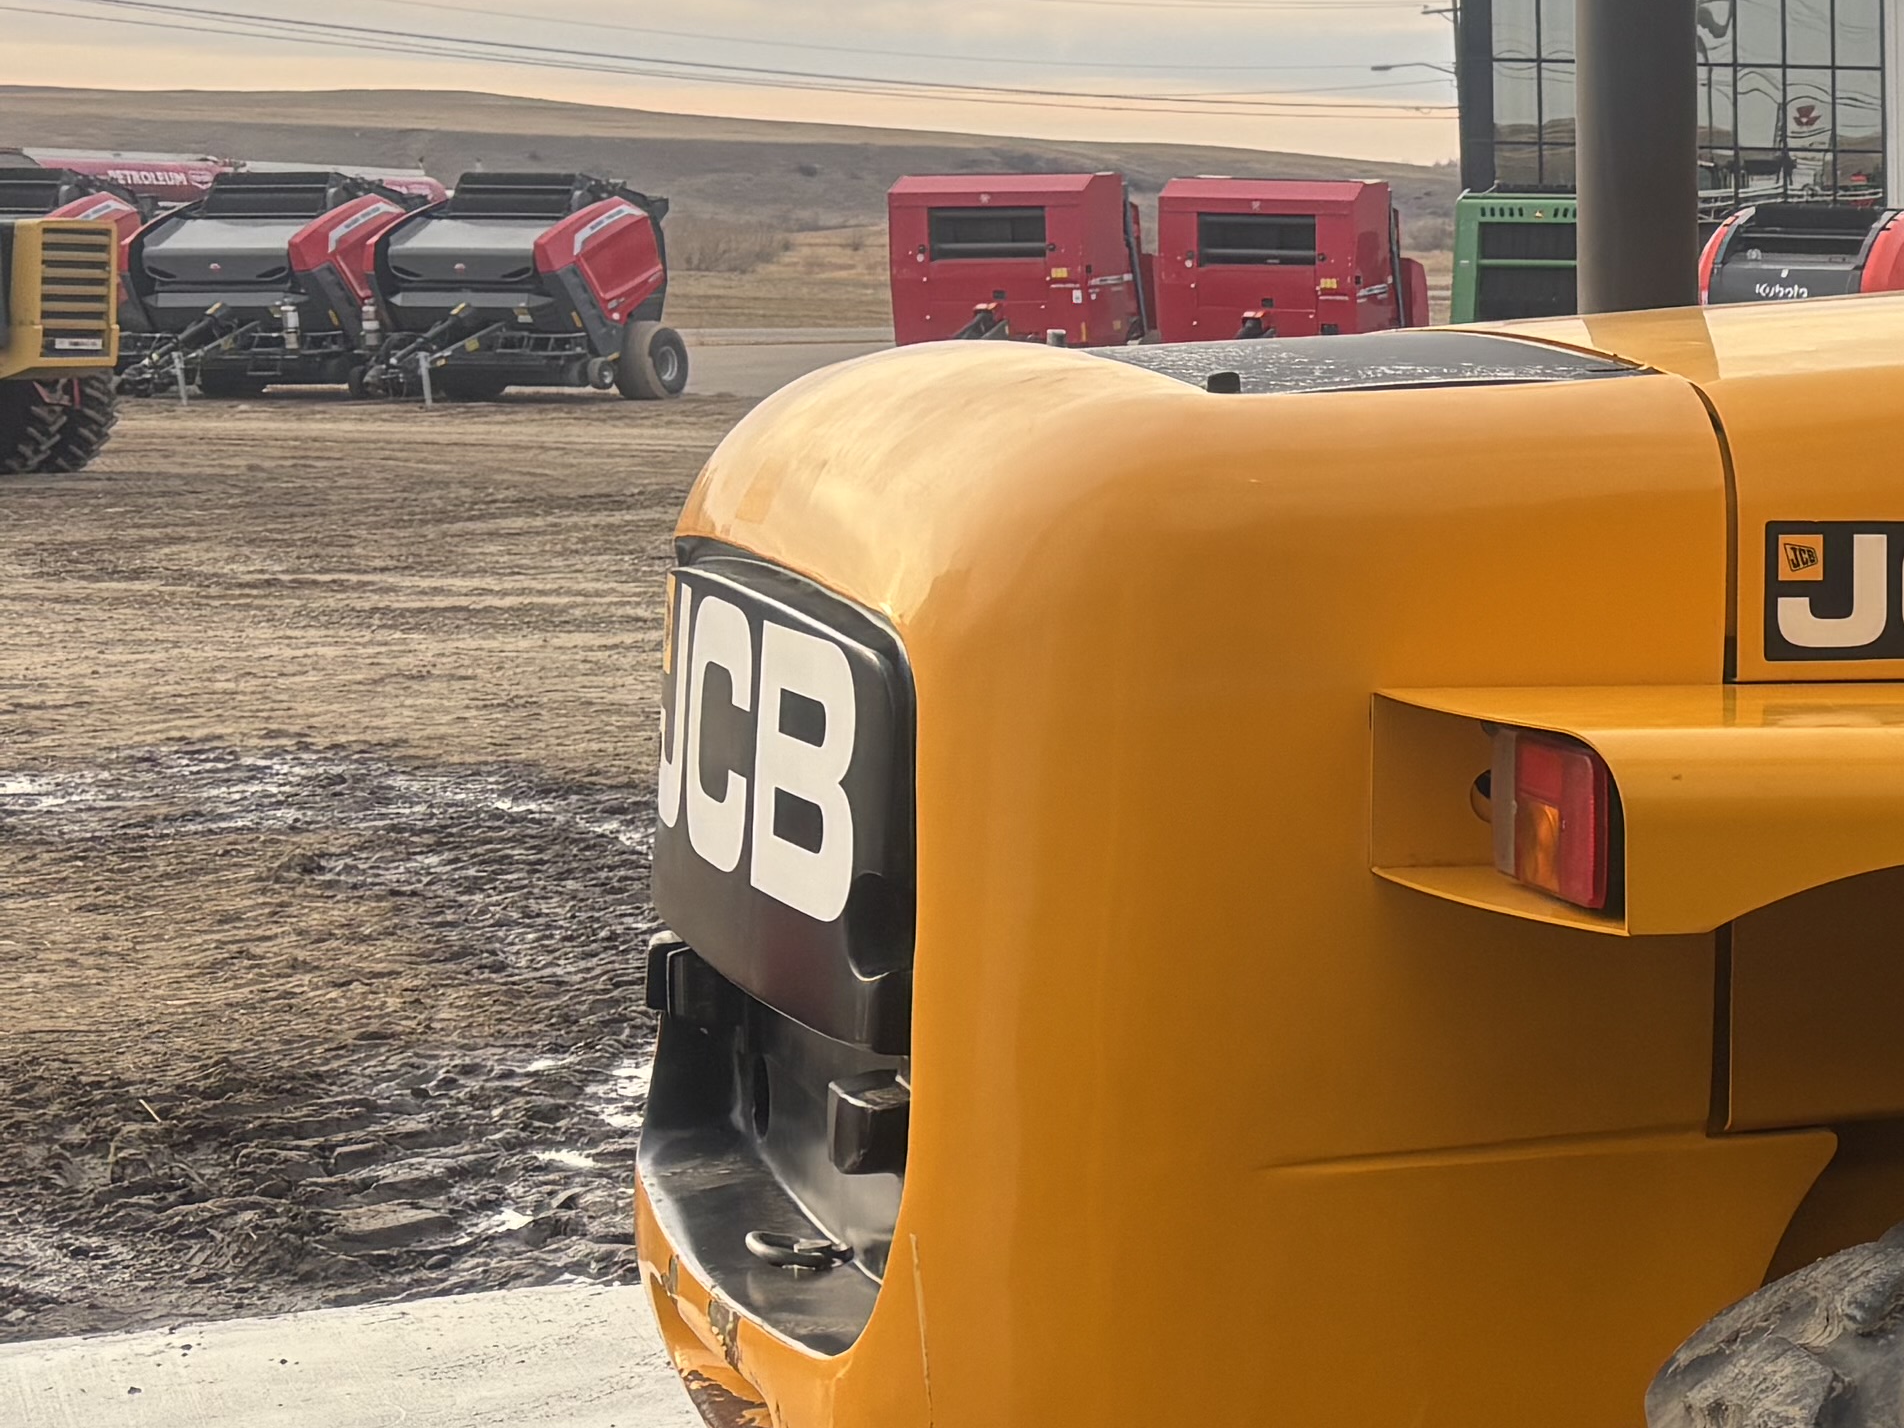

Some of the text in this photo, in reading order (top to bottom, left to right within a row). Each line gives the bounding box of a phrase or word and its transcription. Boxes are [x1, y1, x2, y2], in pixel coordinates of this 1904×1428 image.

[1755, 283, 1808, 299] Kubota
[1787, 545, 1817, 570] JCB
[658, 582, 856, 922] JCB
